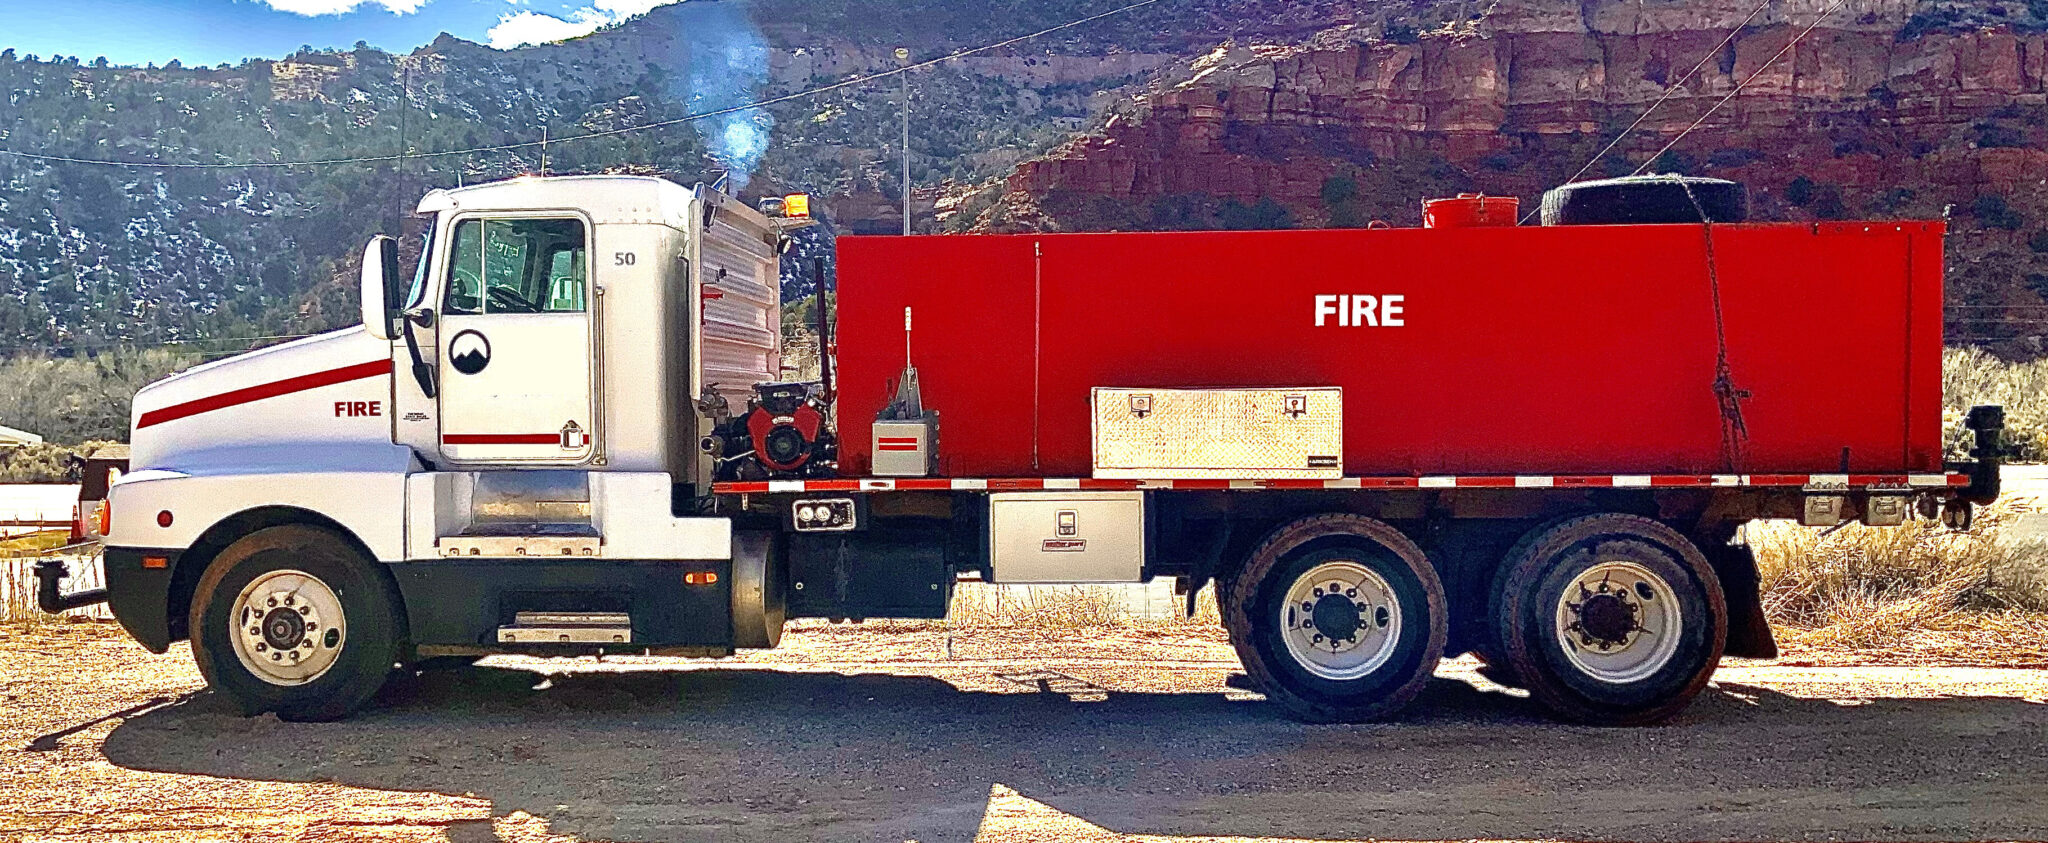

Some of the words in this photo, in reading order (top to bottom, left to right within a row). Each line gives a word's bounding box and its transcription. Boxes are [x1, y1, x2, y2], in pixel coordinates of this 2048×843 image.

[614, 251, 636, 266] 50
[1314, 294, 1405, 327] FIRE
[334, 400, 382, 417] FIRE
